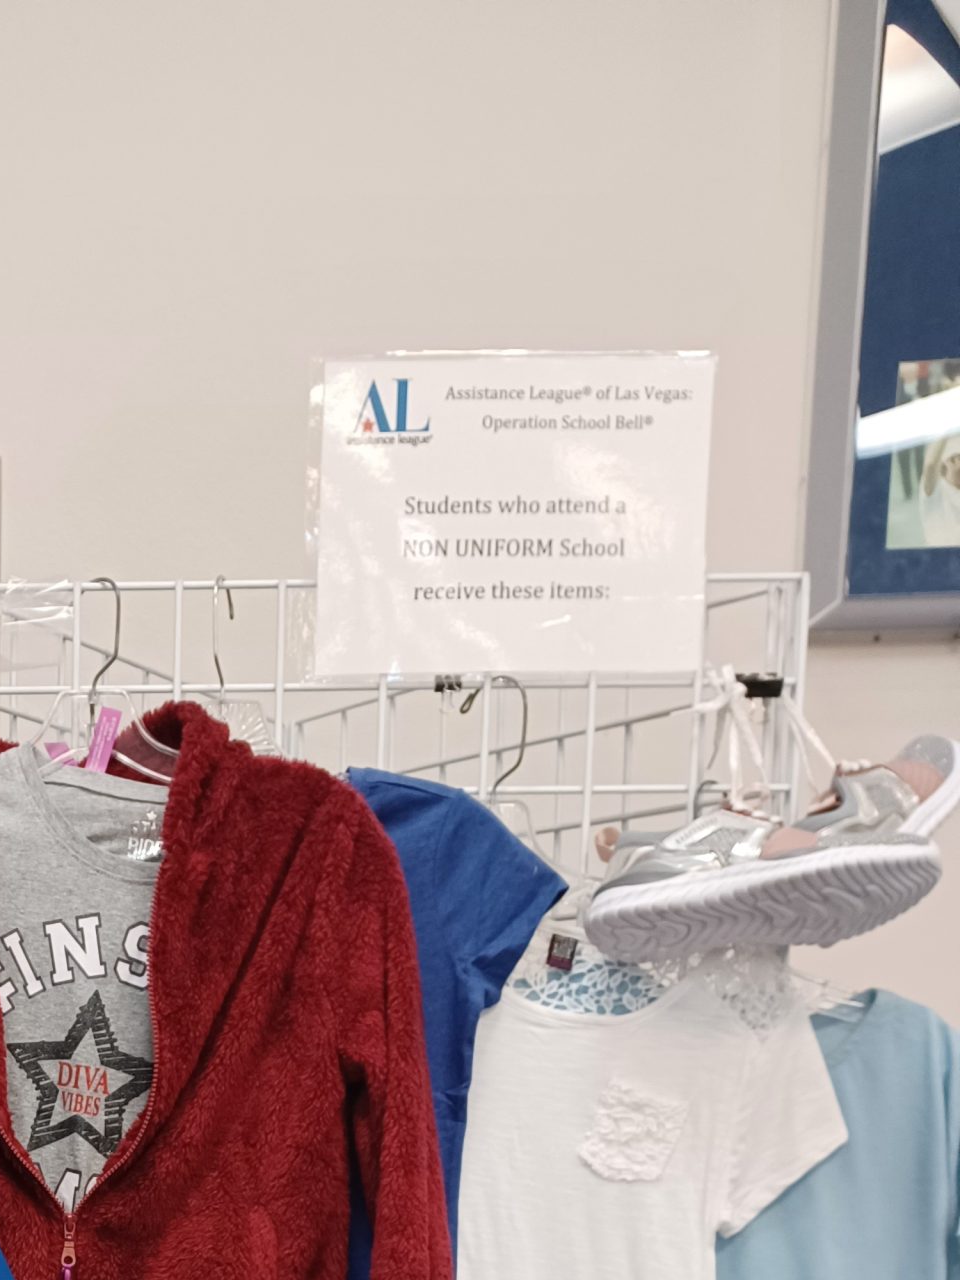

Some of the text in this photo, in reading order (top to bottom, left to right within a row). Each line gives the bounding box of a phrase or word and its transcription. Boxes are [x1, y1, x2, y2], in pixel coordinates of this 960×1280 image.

[444, 385, 525, 401] Assistance
[596, 384, 613, 401] of
[614, 385, 640, 401] Las
[353, 377, 431, 433] AL
[481, 414, 557, 433] Operation
[561, 414, 611, 430] School
[404, 495, 627, 515] Students who attend a
[402, 537, 625, 558] NON UNIFORM School
[413, 580, 611, 601] receive these items:
[56, 1060, 111, 1096] DIVA
[60, 1090, 101, 1118] VIBES
